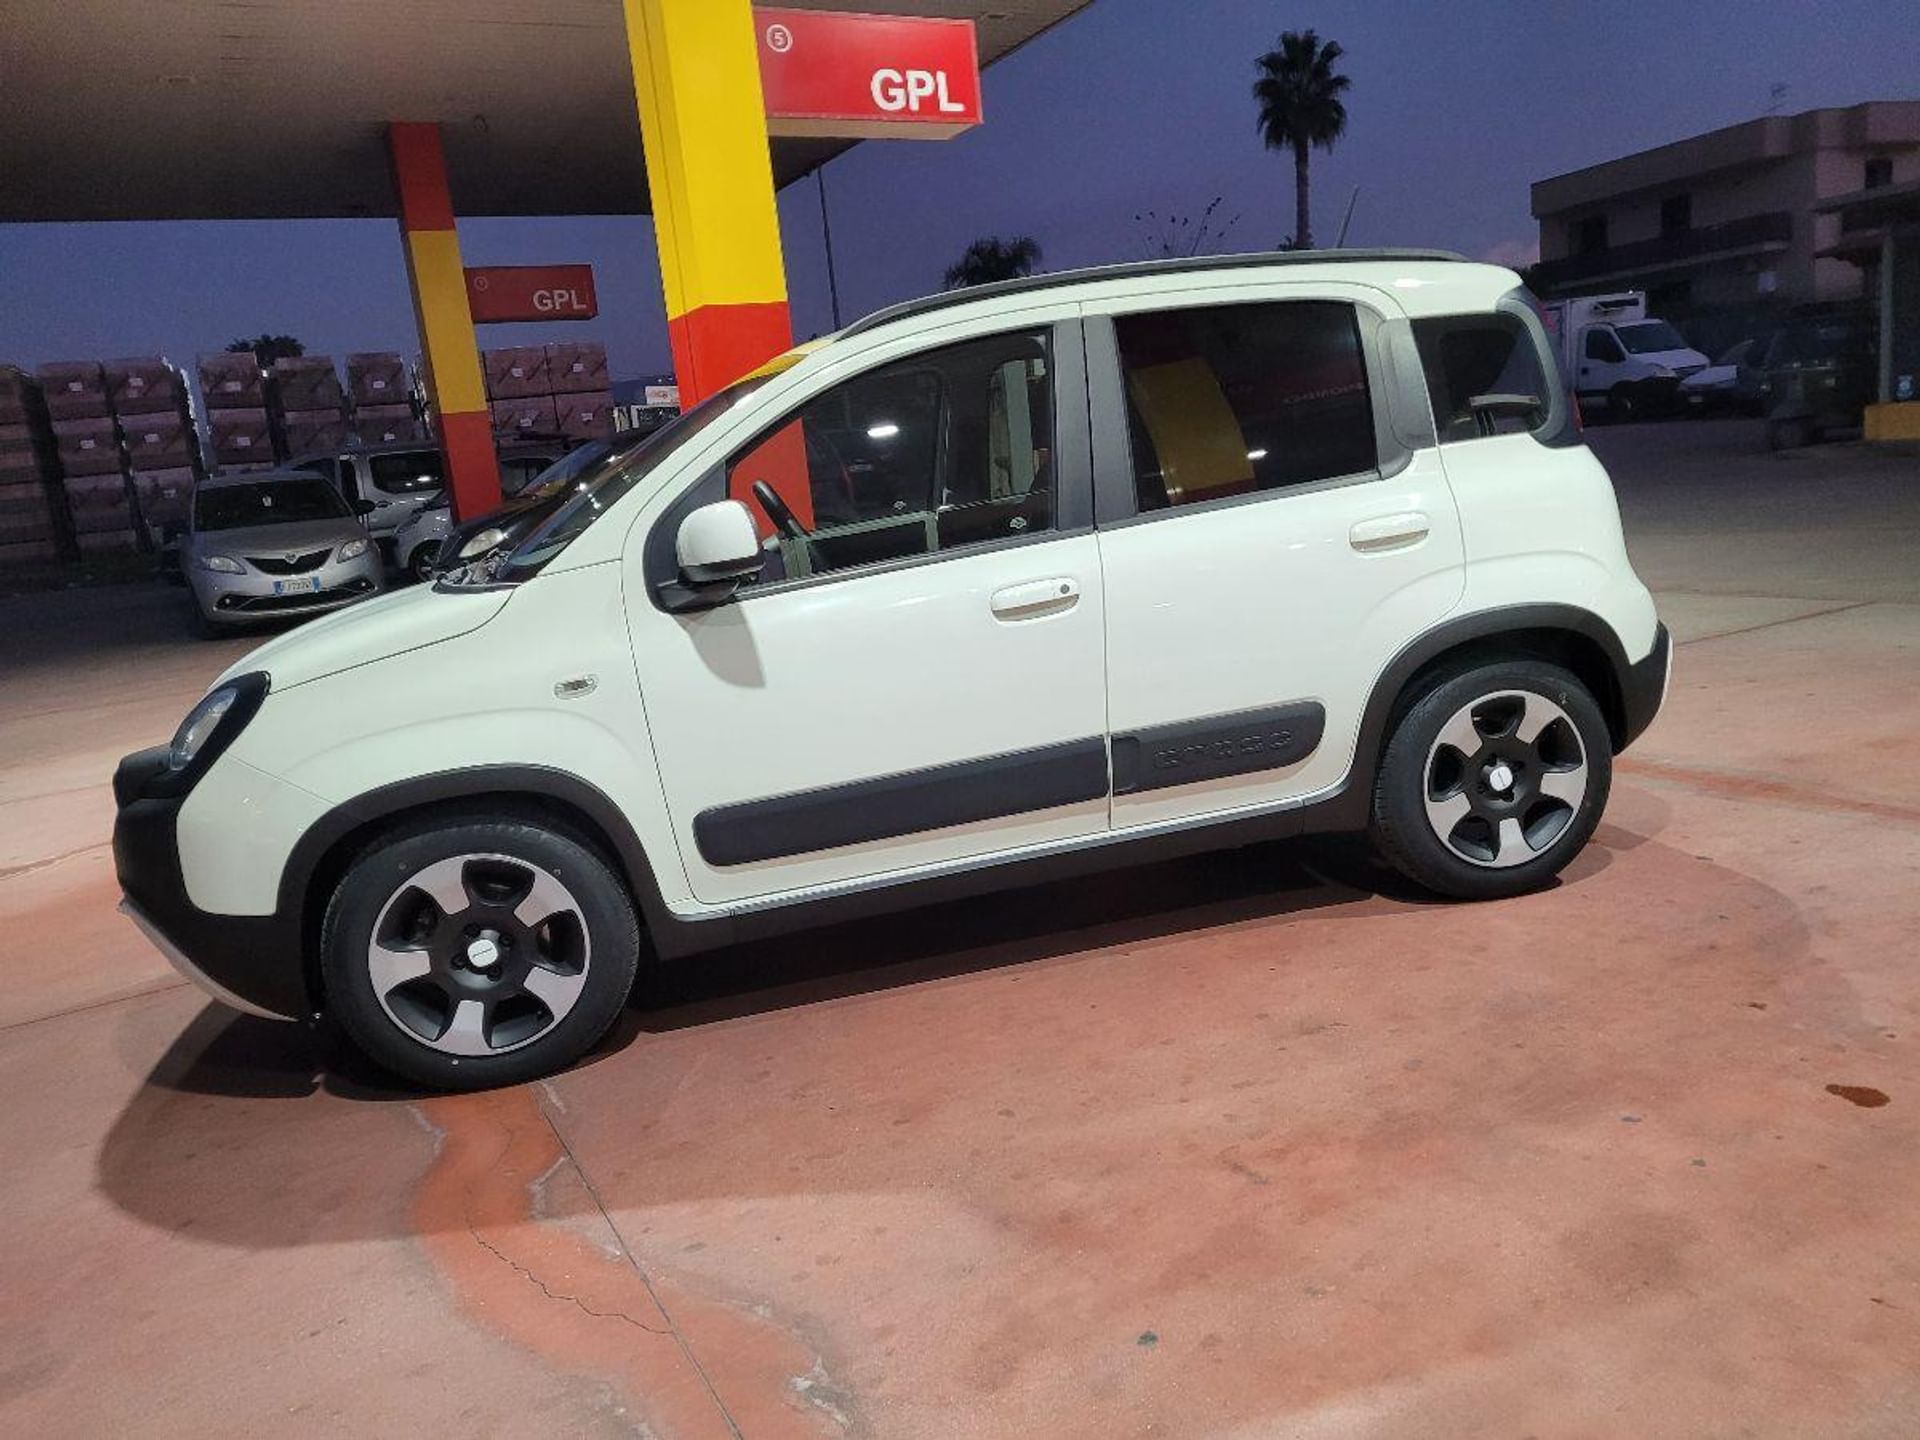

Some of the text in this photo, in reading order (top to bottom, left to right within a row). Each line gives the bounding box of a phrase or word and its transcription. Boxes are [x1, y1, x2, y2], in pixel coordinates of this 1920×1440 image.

[773, 31, 785, 46] 5
[870, 68, 965, 112] GPL
[532, 289, 587, 311] GPL
